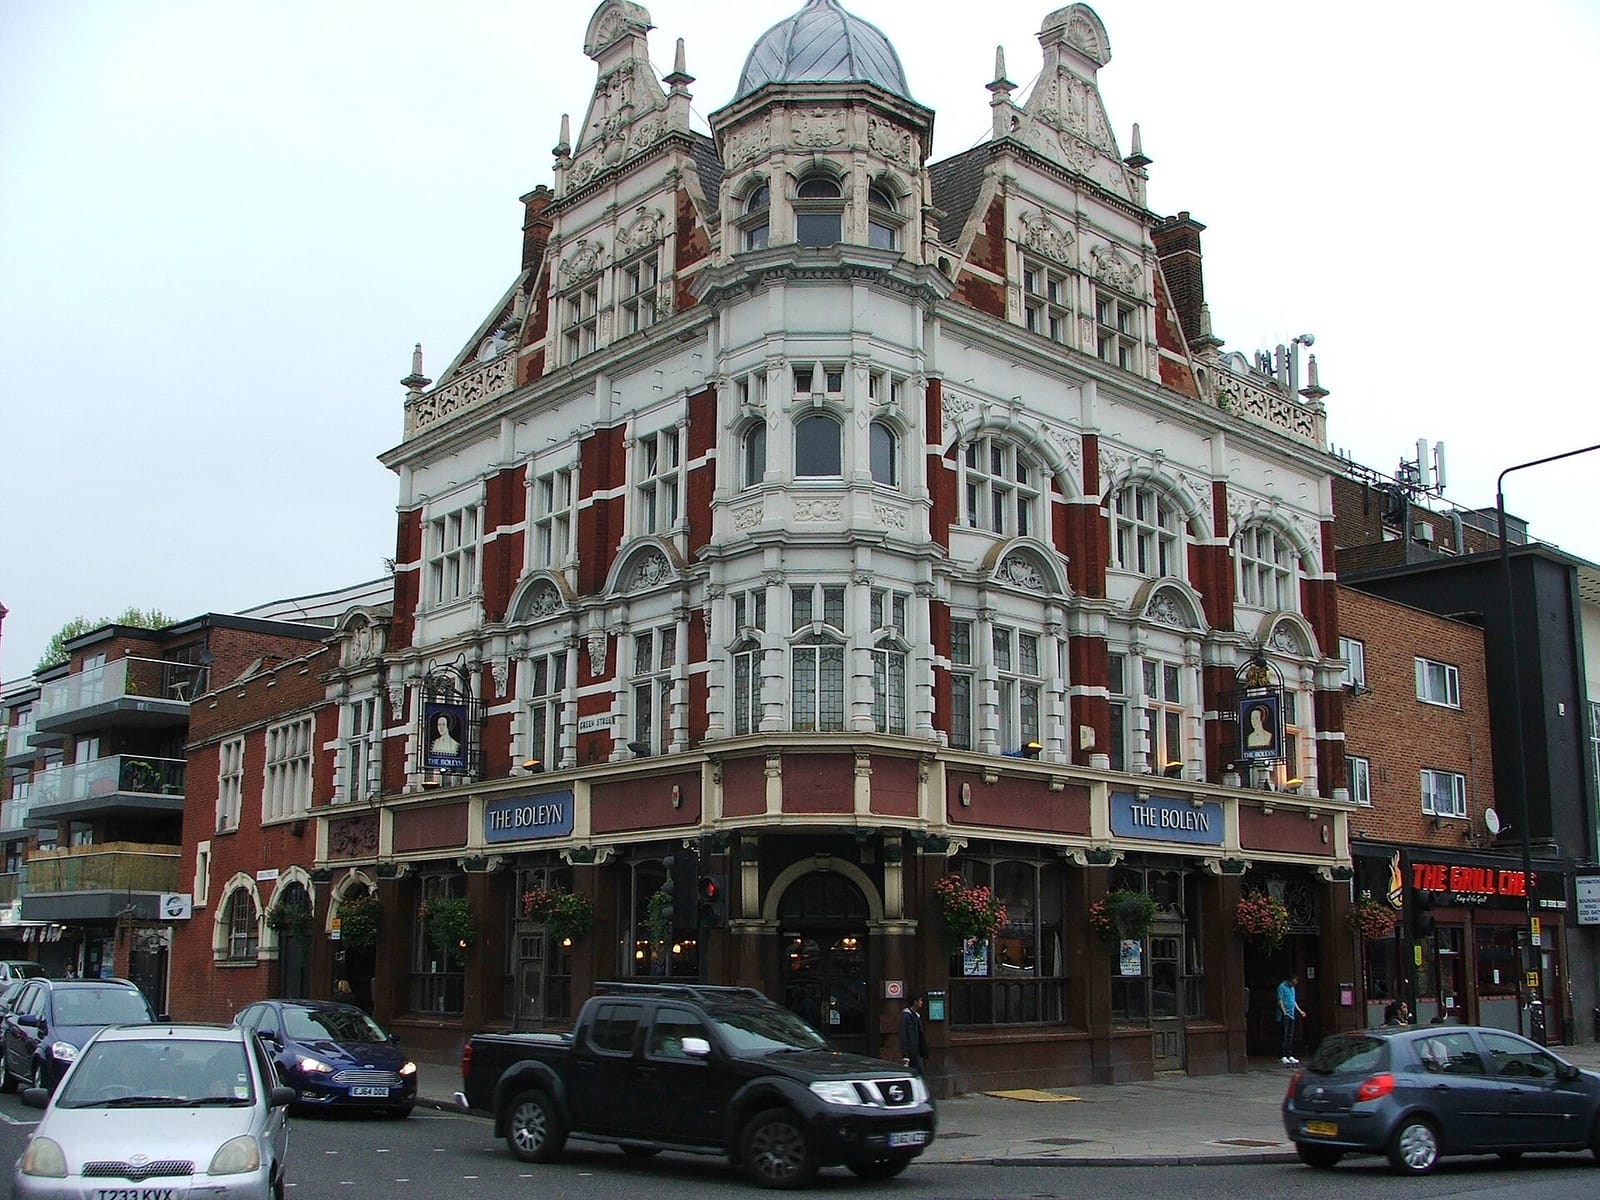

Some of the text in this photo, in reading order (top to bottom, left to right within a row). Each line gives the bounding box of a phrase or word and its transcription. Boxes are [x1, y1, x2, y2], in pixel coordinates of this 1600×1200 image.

[580, 715, 616, 730] GREEN STREET
[427, 758, 465, 767] THE BOLEYN
[489, 803, 564, 830] THE BOLEYN
[1130, 805, 1209, 832] THE BOLEYN
[1412, 863, 1448, 892] THE
[1450, 866, 1496, 894] GRILL
[98, 1189, 172, 1200] T233 KVX
